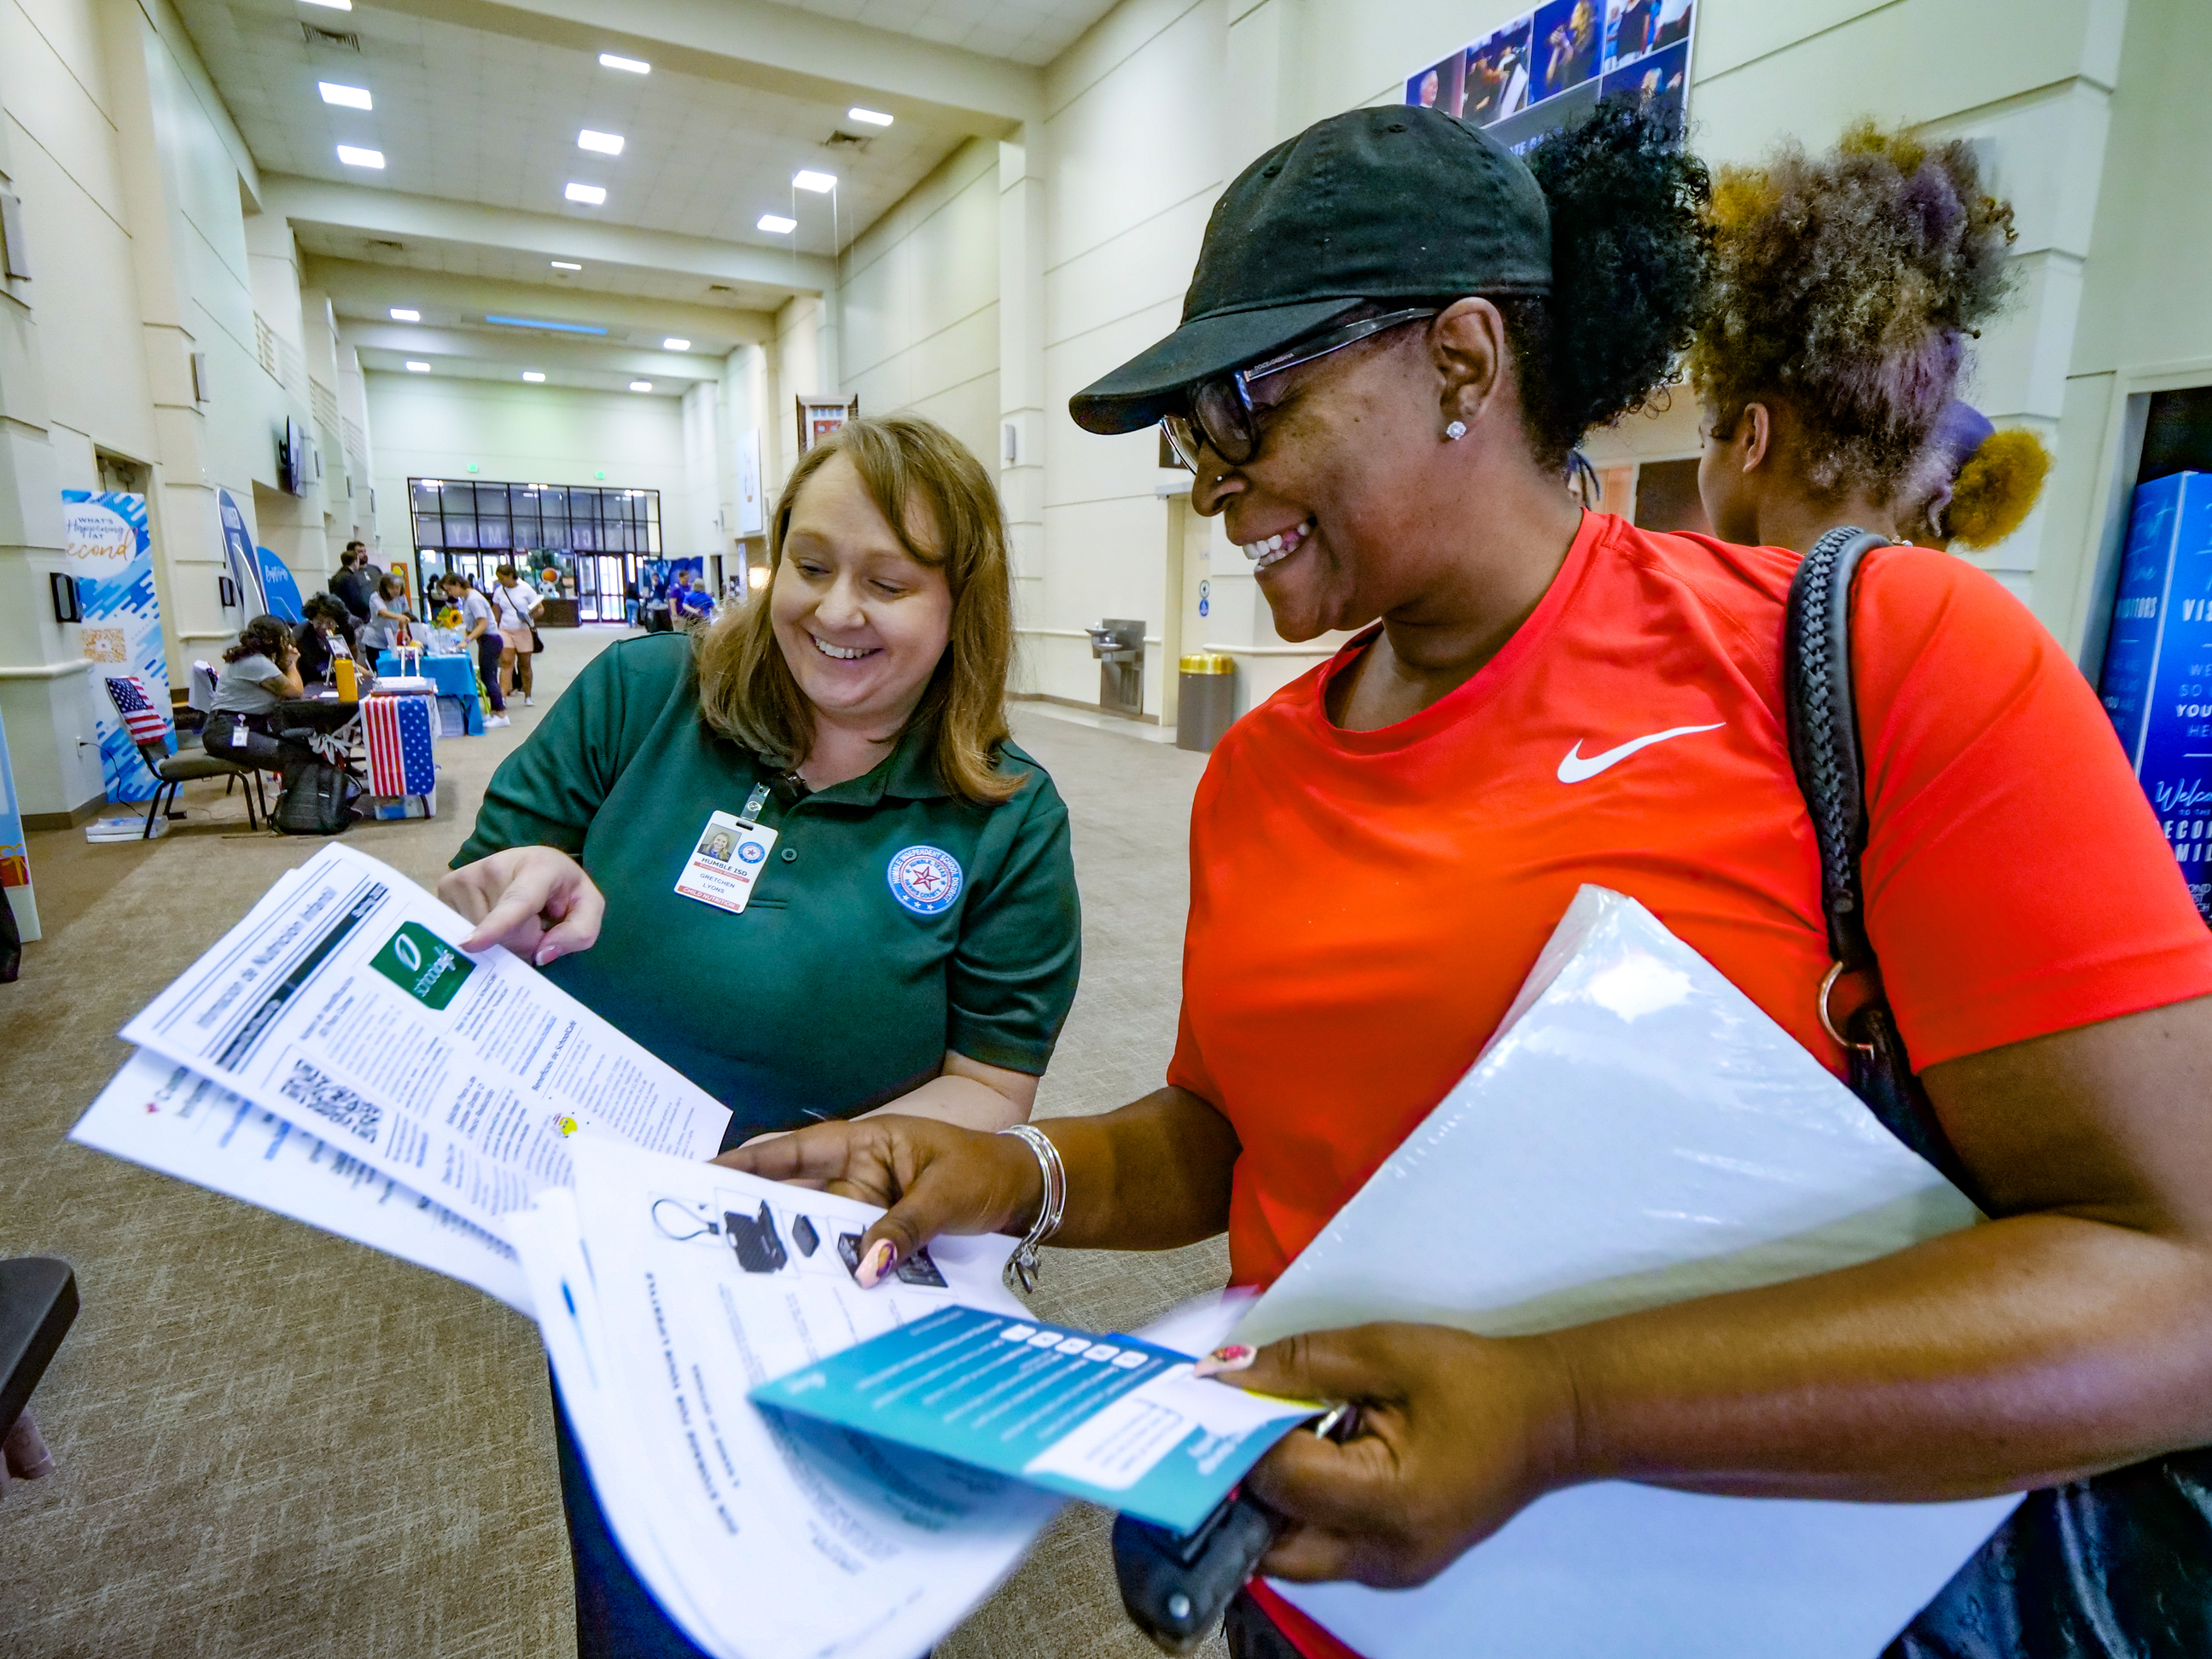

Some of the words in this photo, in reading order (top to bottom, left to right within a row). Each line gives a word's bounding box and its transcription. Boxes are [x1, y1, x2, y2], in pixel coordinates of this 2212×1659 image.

[78, 516, 114, 525] WHAT'S
[2163, 820, 2212, 840] ECO
[701, 857, 732, 871] HUMBLE
[940, 854, 959, 878] SCHOOL
[700, 873, 735, 888] GRETCHEN
[703, 883, 725, 894] LYONS
[684, 888, 701, 898] CHILD
[702, 892, 736, 908] NUTRITION
[943, 876, 960, 904] DISTRICT
